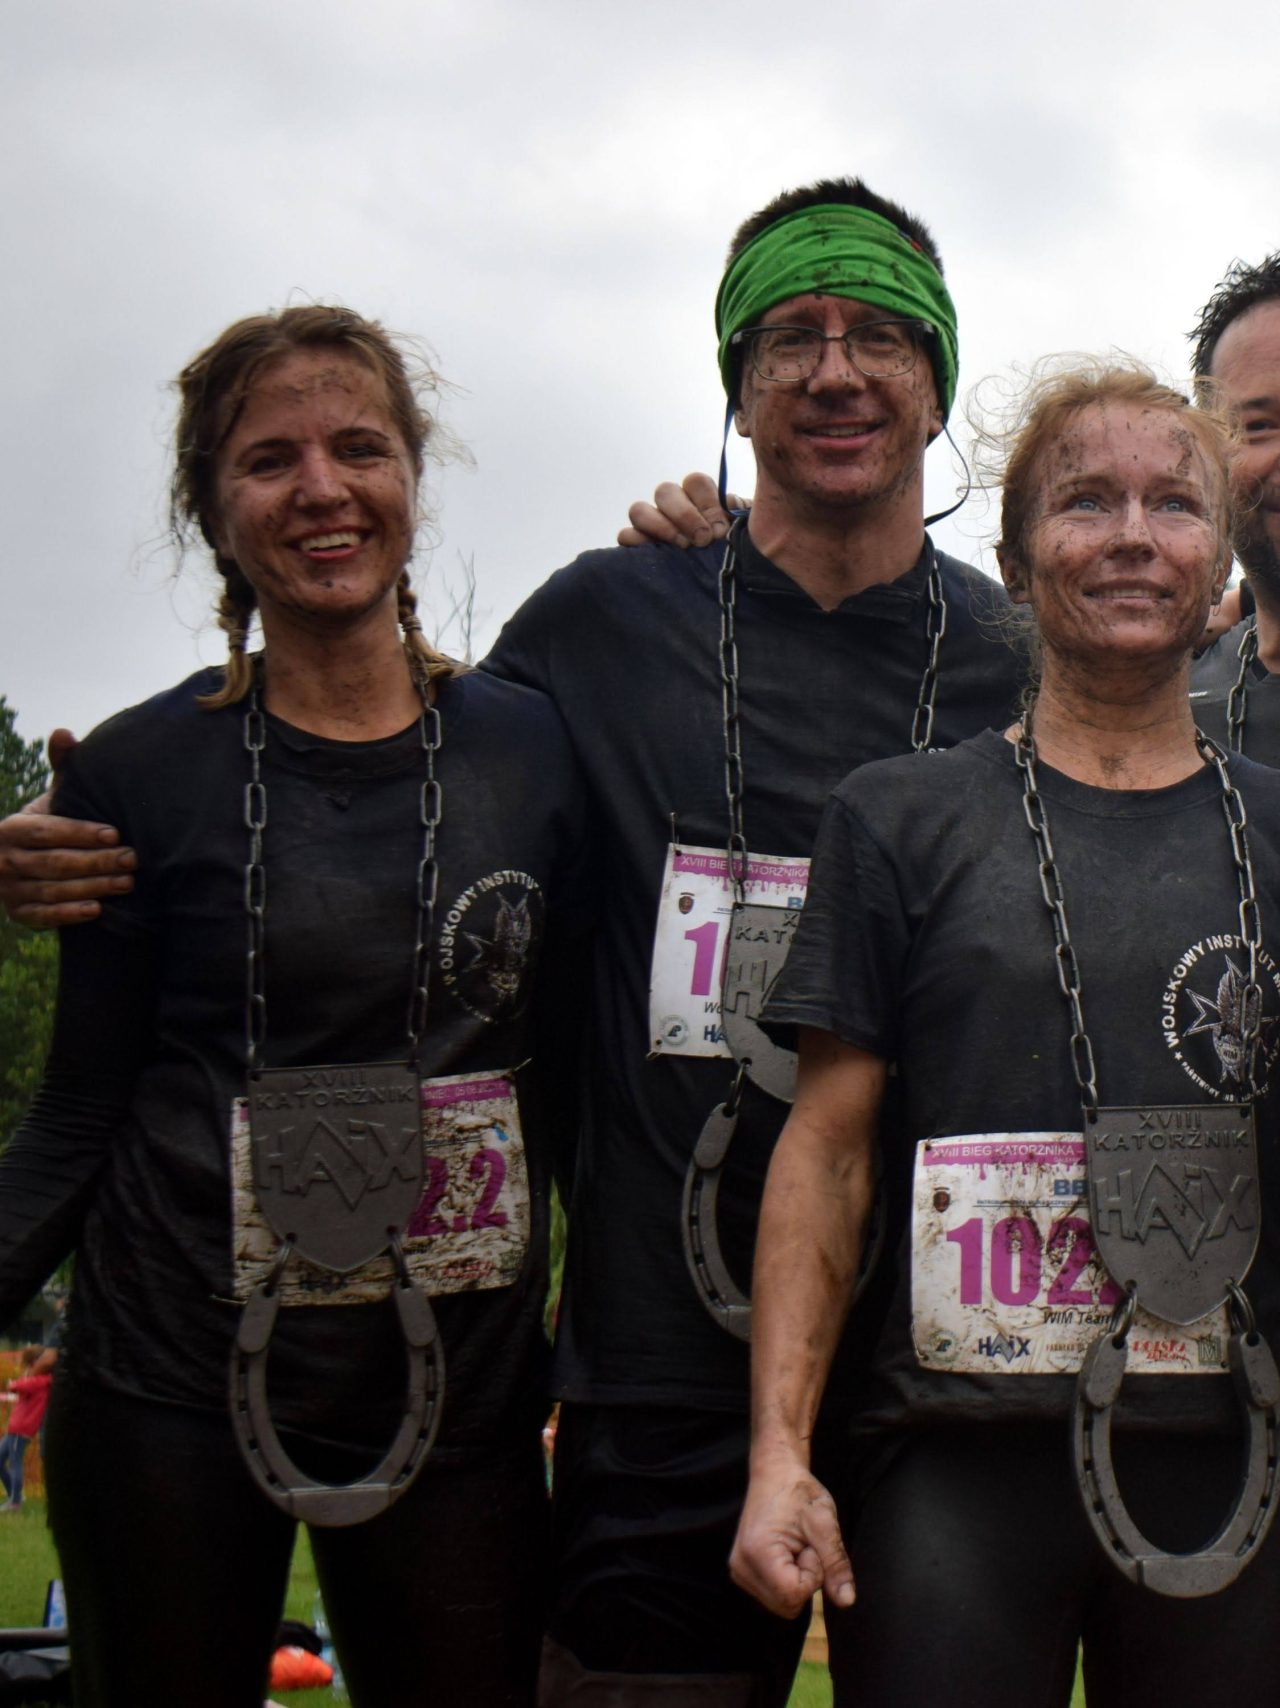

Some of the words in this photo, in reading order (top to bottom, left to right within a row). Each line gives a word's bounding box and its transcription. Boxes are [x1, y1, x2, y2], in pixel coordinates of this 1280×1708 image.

[710, 859, 739, 870] BIE
[1162, 942, 1205, 1048] WOJSKOWY
[1206, 934, 1276, 972] INSTUT
[1139, 1111, 1202, 1129] XVIII
[962, 1145, 992, 1157] BIEG
[946, 1217, 1124, 1306] 102
[1043, 1312, 1073, 1324] WIM
